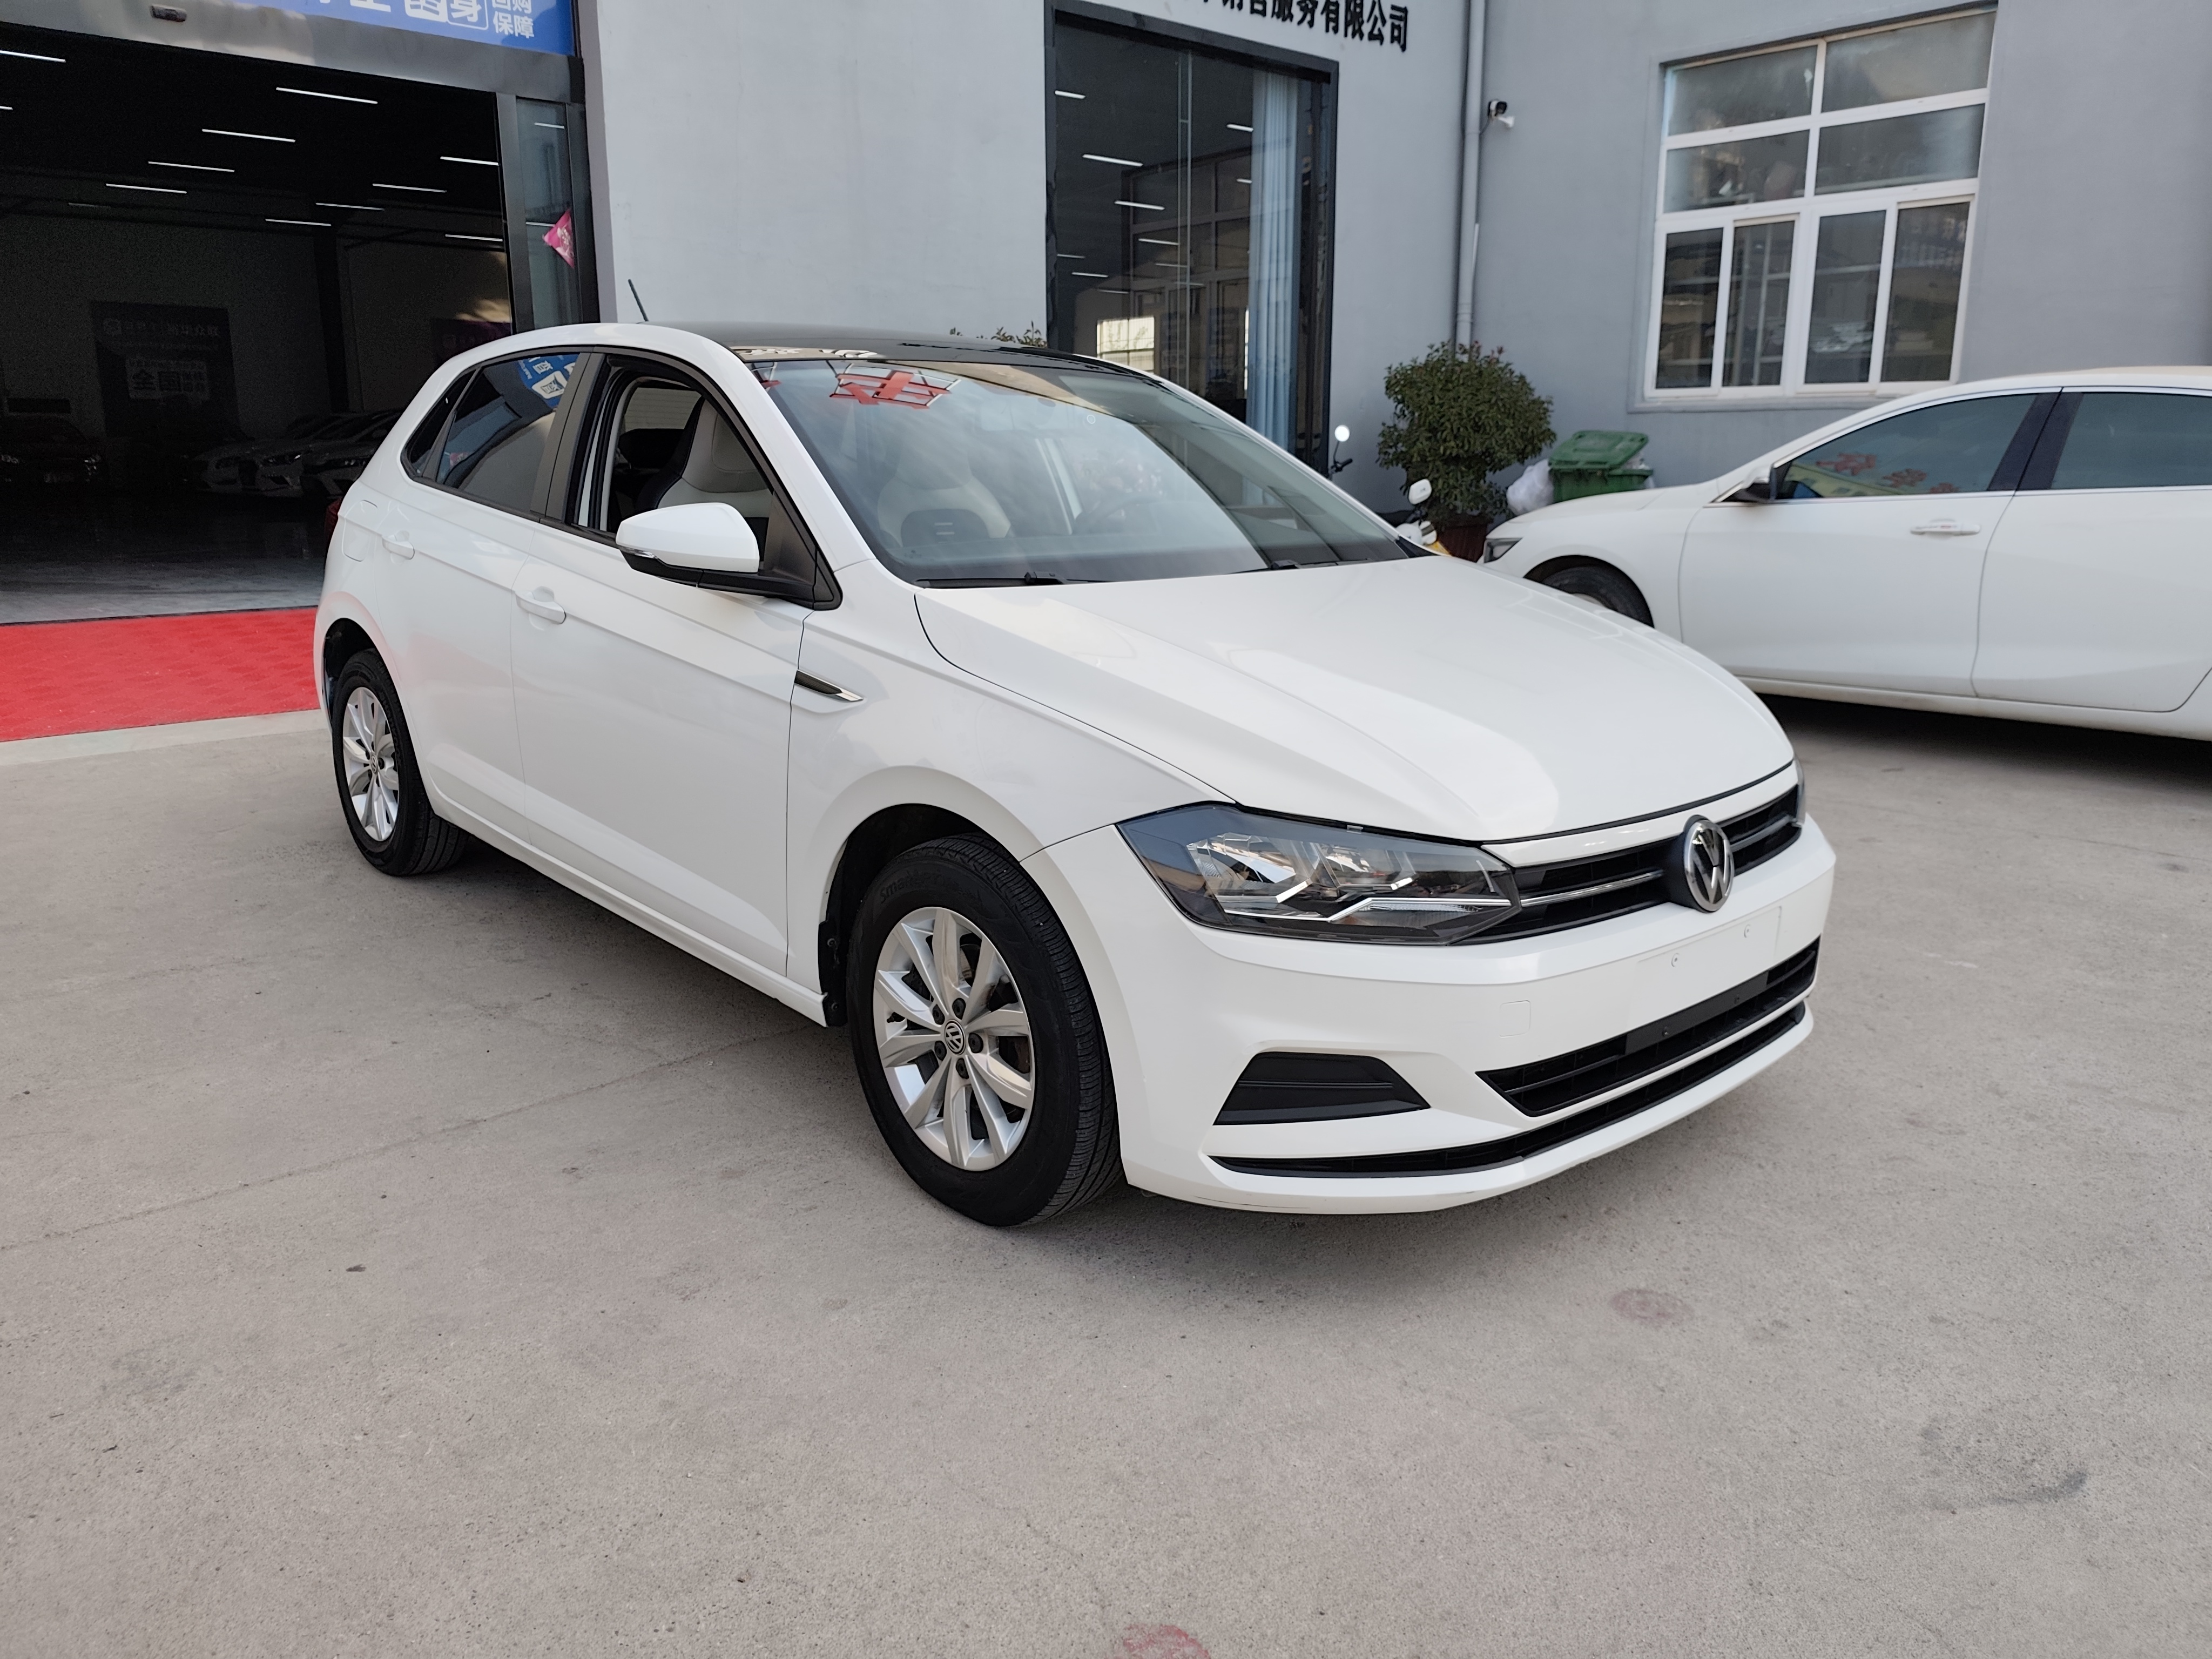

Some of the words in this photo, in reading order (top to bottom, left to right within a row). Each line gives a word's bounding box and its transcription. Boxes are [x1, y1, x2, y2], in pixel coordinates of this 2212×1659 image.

[493, 11, 535, 39] 保障
[1203, 0, 1408, 52] 务有限公司
